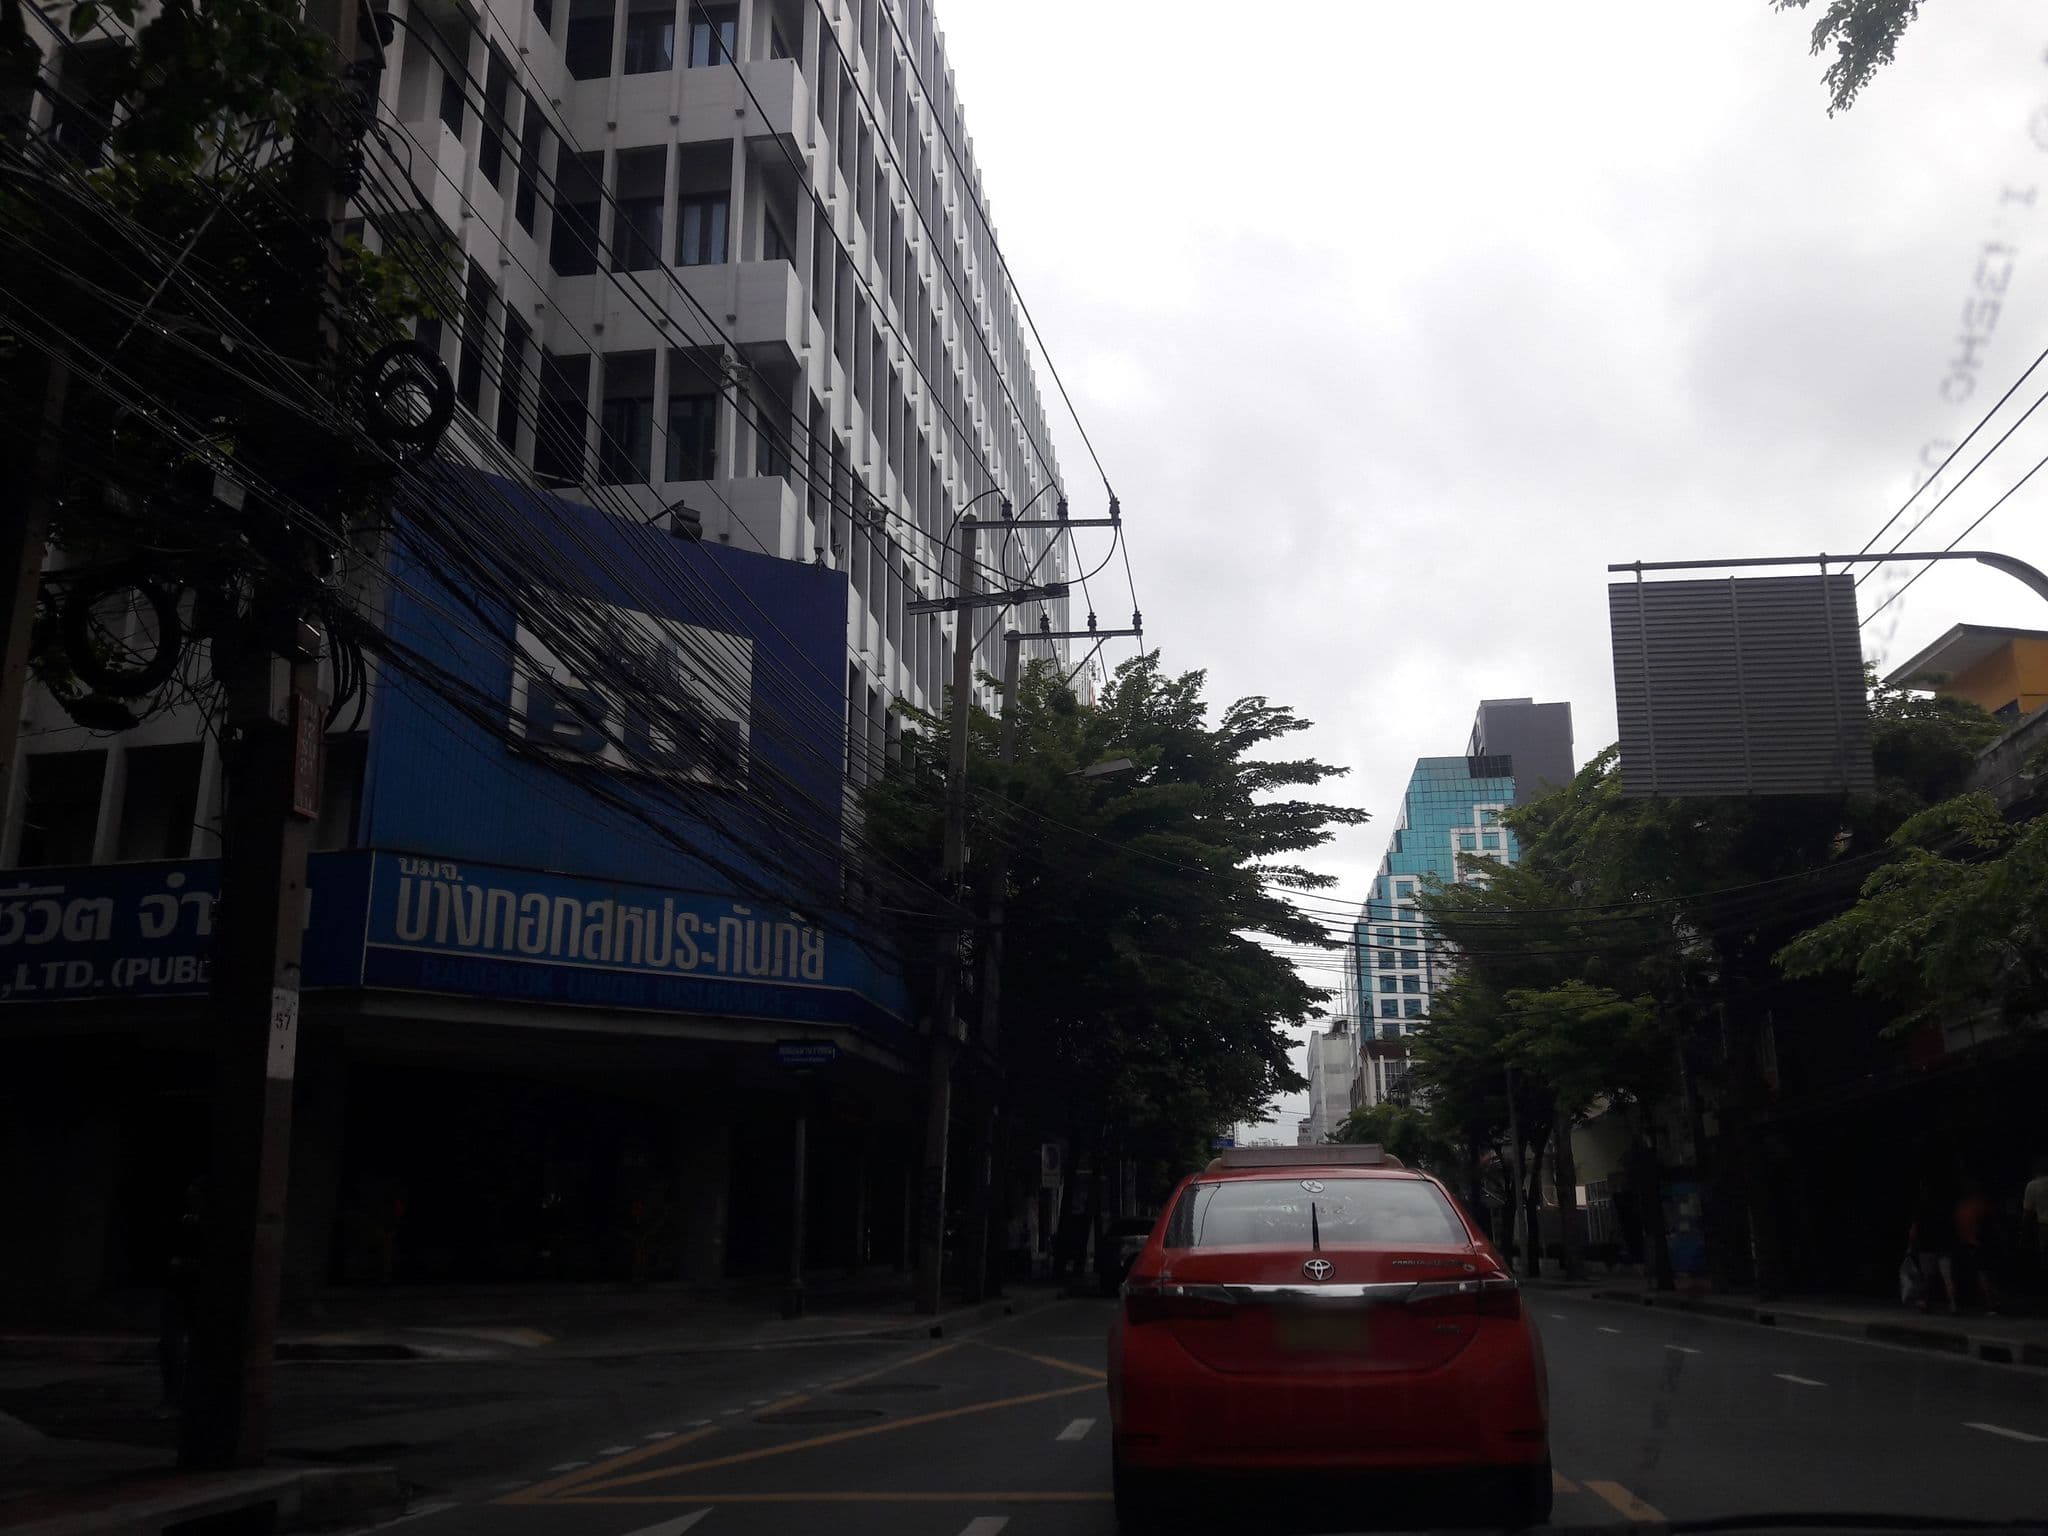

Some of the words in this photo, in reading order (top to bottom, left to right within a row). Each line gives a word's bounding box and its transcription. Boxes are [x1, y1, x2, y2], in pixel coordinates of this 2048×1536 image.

[397, 856, 464, 881] บมจ.
[396, 877, 825, 980] บางกอกสหประกันภัย
